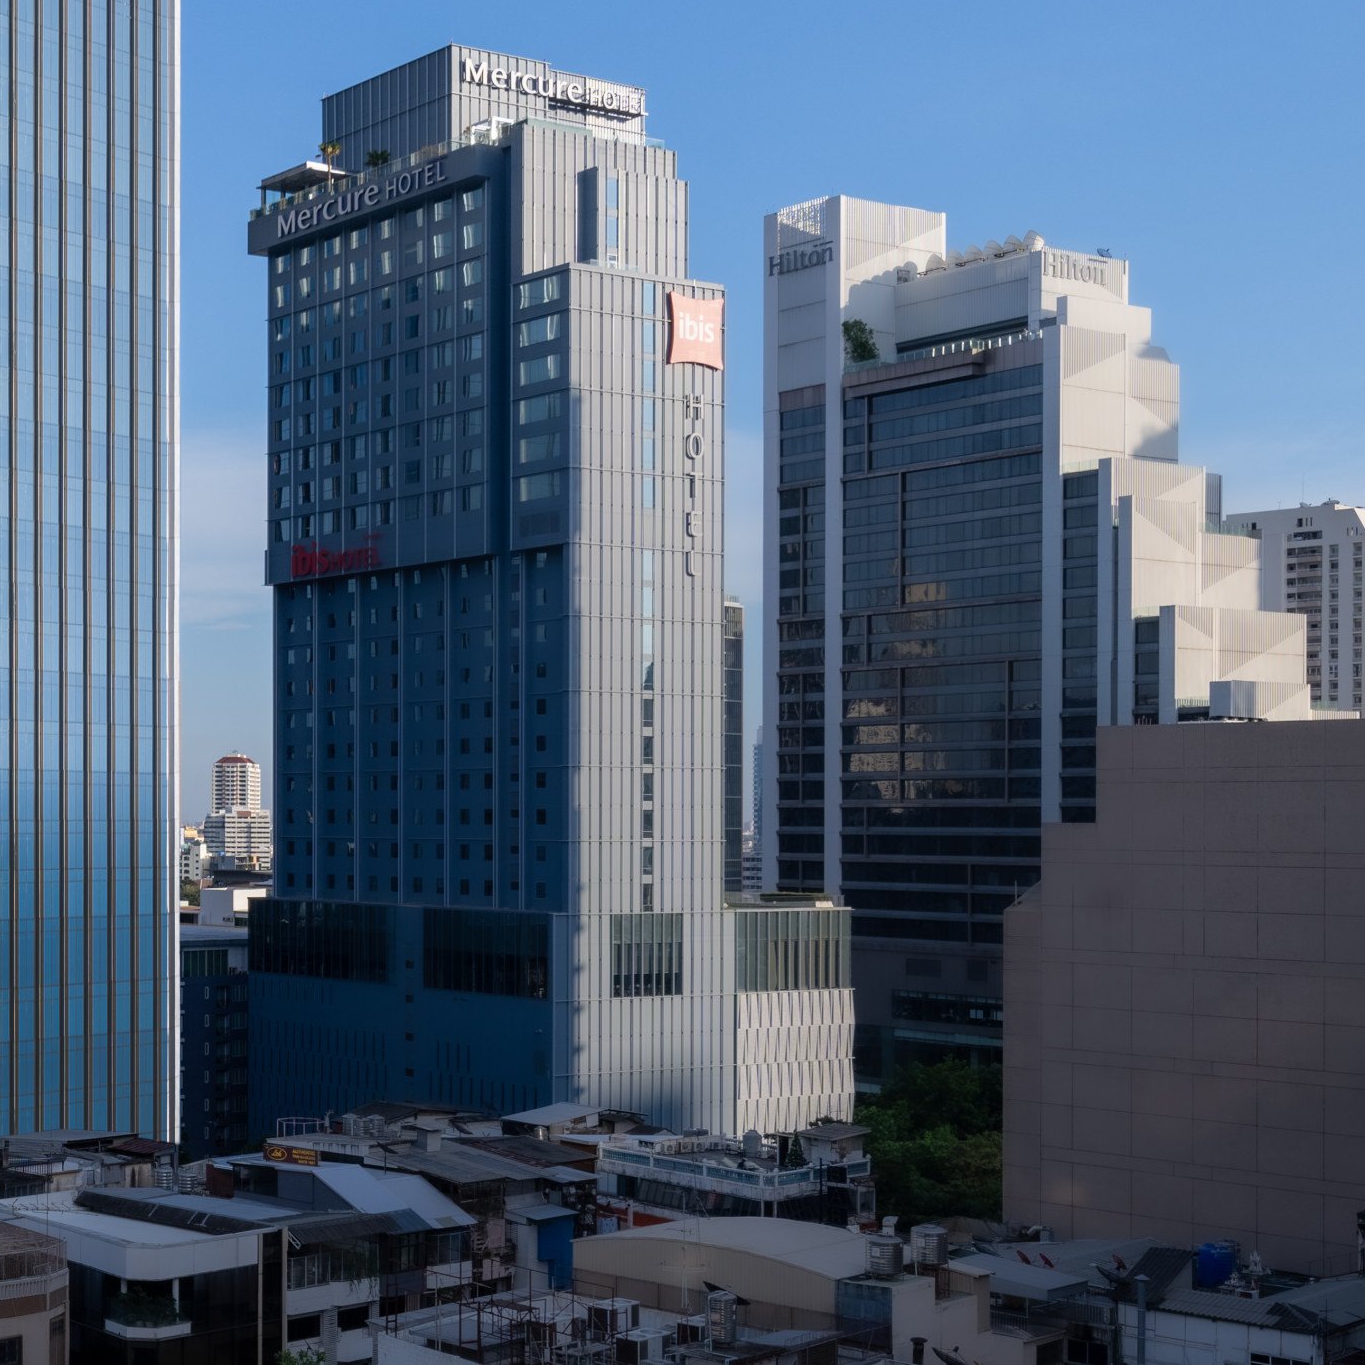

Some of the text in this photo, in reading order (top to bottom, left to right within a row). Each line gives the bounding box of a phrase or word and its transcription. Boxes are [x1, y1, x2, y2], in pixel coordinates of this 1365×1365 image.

[465, 58, 648, 116] Mercure HOTEL
[277, 161, 446, 238] Mercure HOTEL
[769, 246, 833, 276] Hilton
[1043, 251, 1106, 285] Hilton
[679, 311, 715, 343] ibis
[686, 393, 704, 576] HOTEL
[292, 540, 328, 577] ibis
